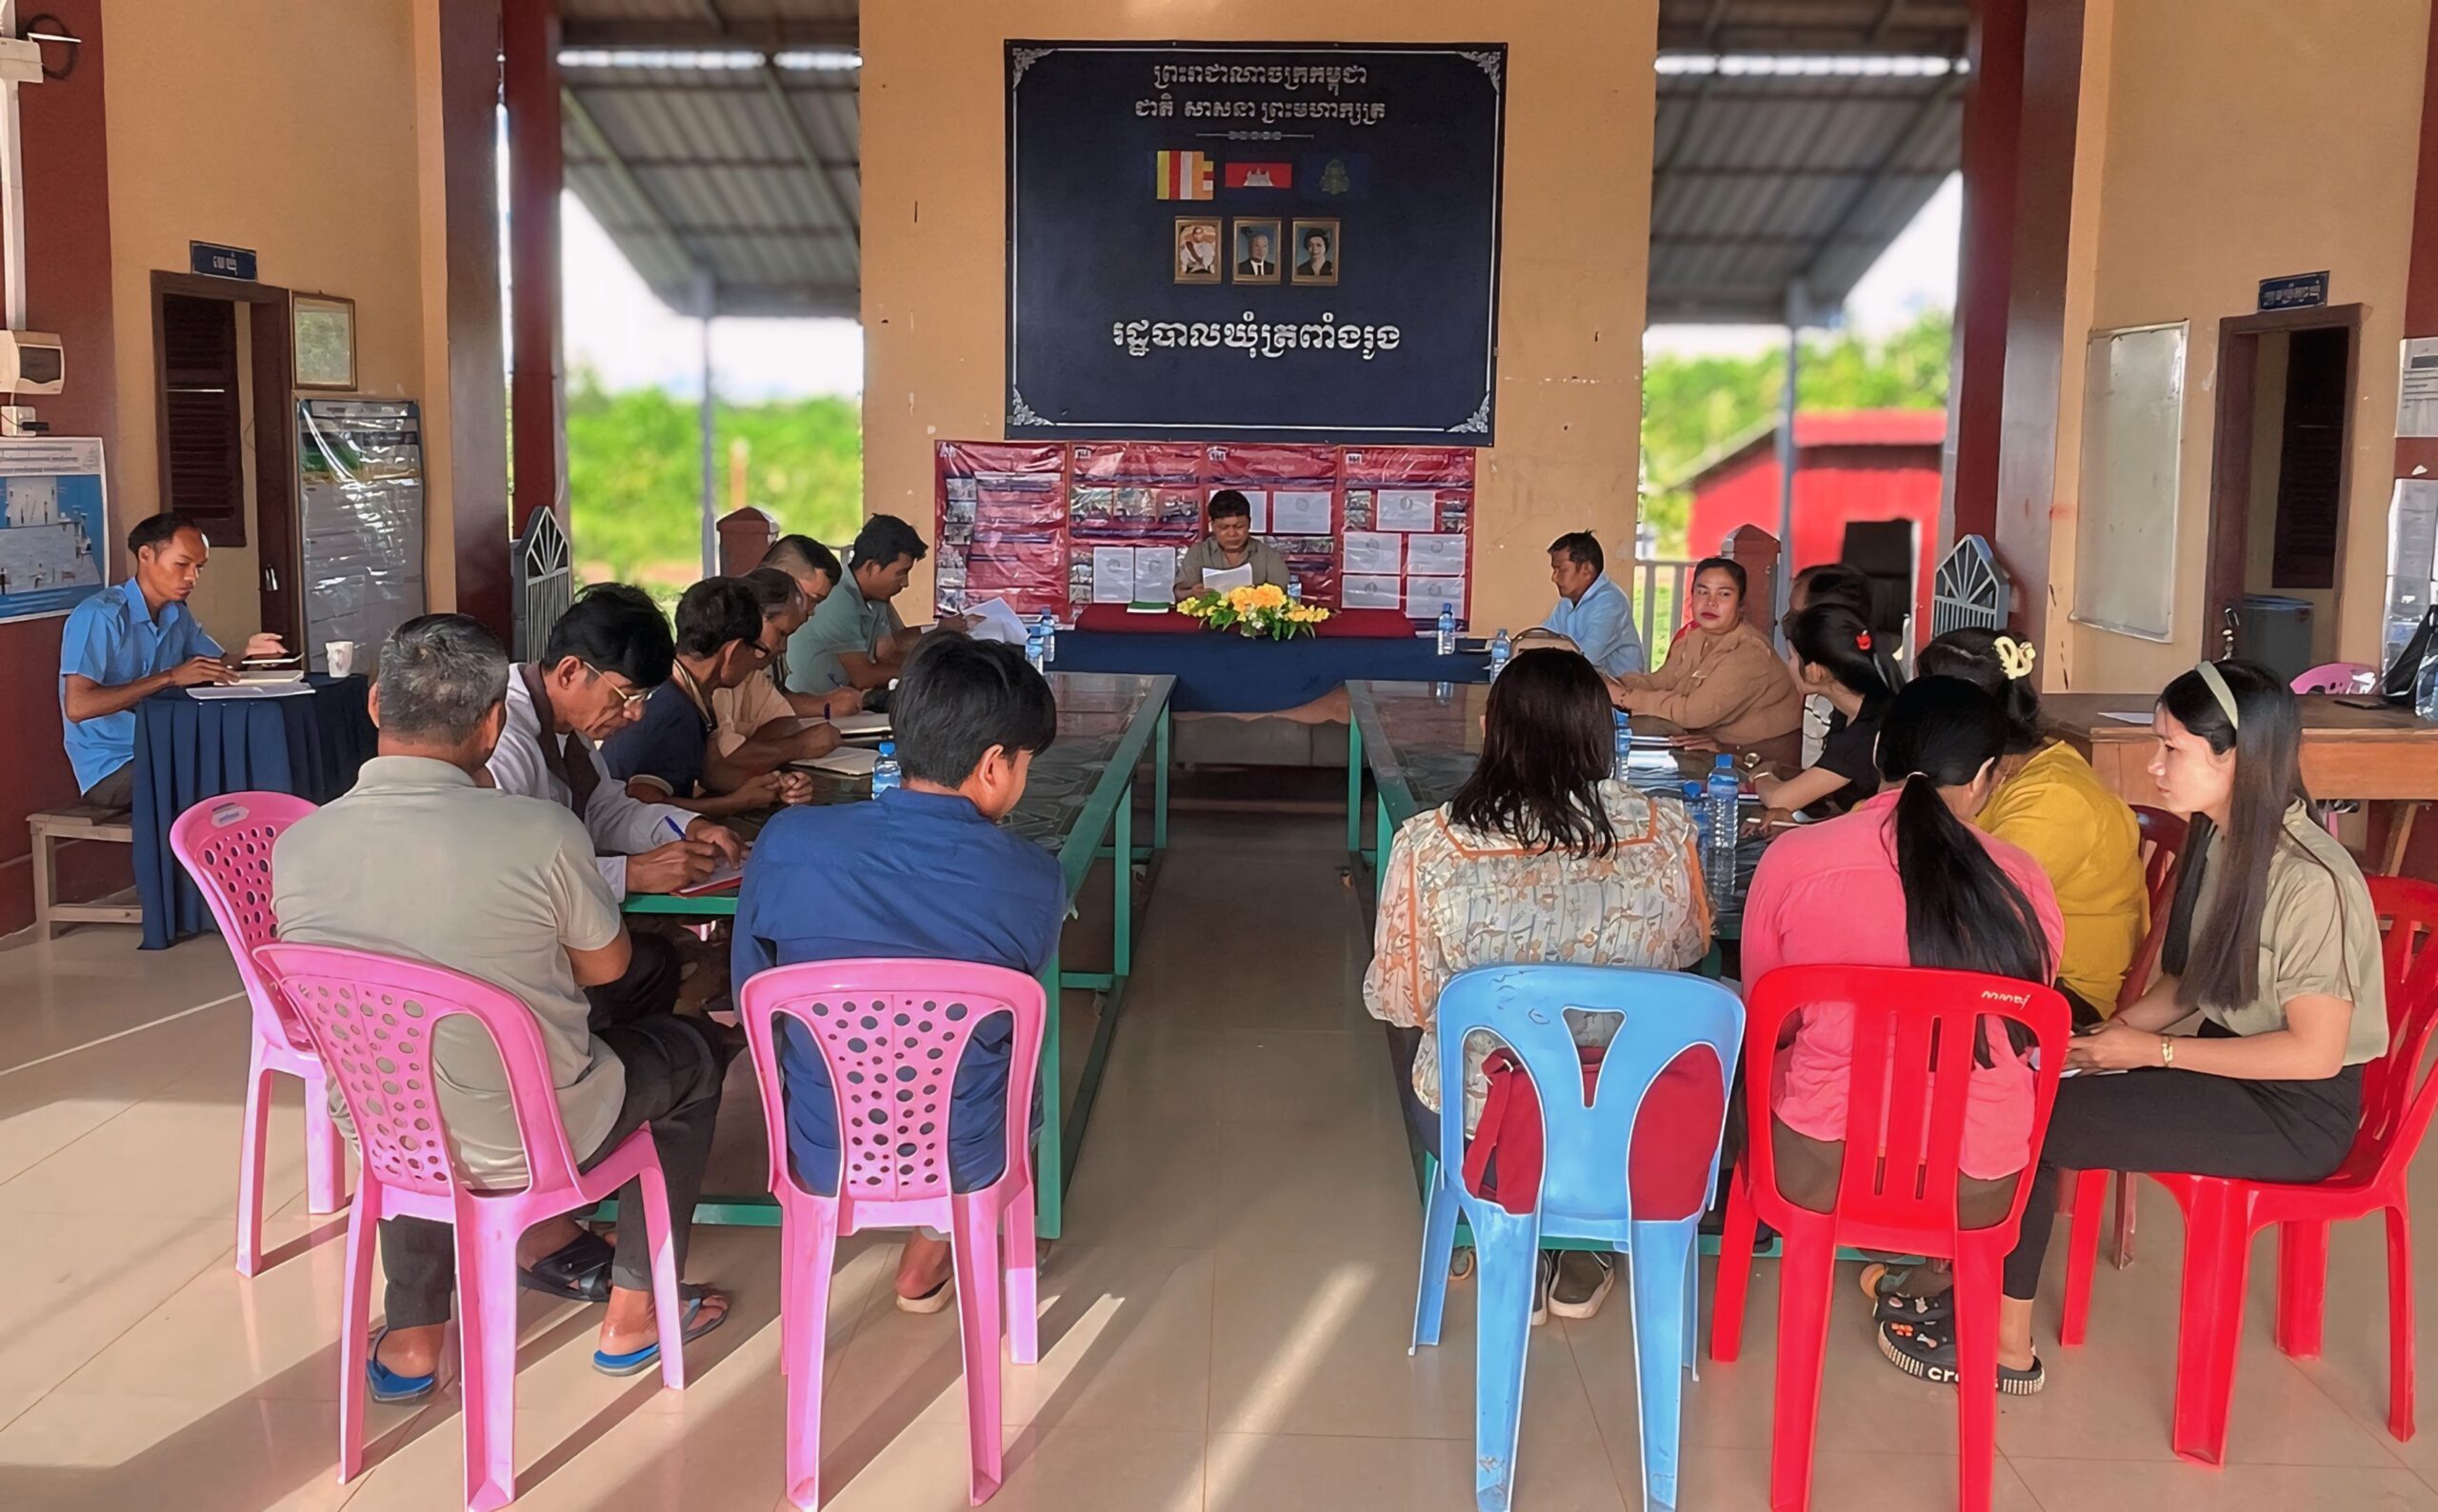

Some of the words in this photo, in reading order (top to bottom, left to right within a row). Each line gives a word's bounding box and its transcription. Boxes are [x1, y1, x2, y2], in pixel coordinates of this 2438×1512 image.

[1153, 63, 1368, 96] ព្រះរាជាណាចក្រកម្ពុជា
[1135, 92, 1174, 117] ជាតិ
[1184, 100, 1256, 118] សាសនា
[1261, 101, 1386, 126] ព្រះមហាក្សត្រ
[1112, 310, 1401, 360] រដ្ឋបាលឃុំត្រពាំងរូង
